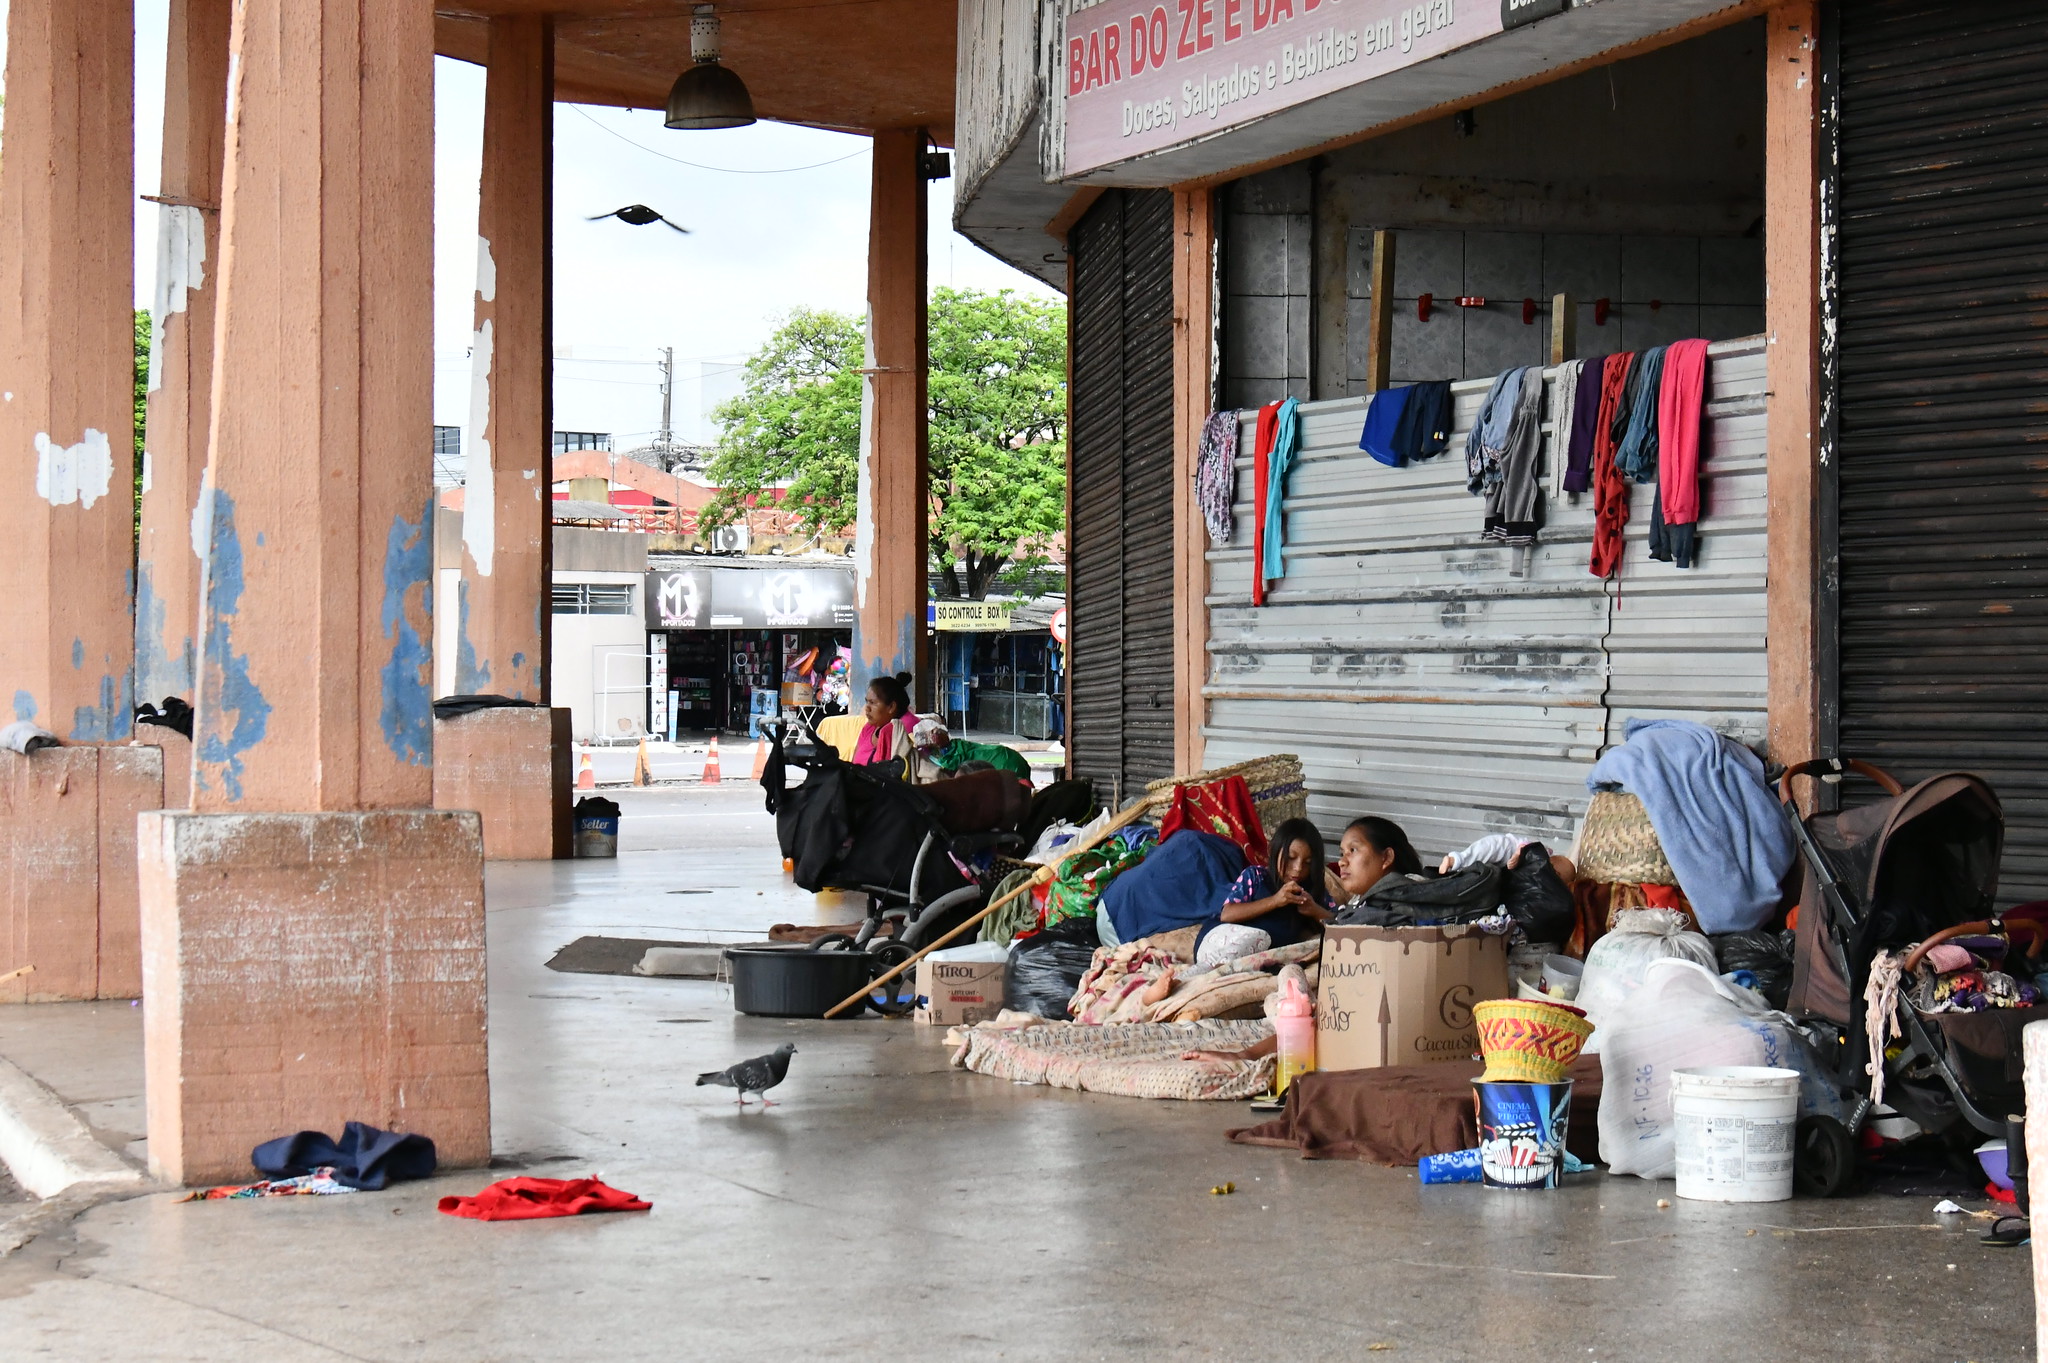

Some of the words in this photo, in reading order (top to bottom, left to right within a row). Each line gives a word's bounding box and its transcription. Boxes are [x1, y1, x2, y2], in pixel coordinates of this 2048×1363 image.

[1069, 22, 1122, 98] BAR
[1130, 5, 1168, 78] DO
[1223, 0, 1242, 45] E
[1123, 96, 1177, 137] Doces,
[1181, 62, 1260, 119] Salgados
[1265, 59, 1277, 90] e
[1282, 27, 1357, 85] Bebidas
[1363, 16, 1395, 55] em
[1400, 0, 1454, 53] geral
[948, 606, 982, 619] CONTROLE
[987, 606, 1000, 619] BOX
[938, 964, 977, 979] TIROL
[1414, 1033, 1482, 1053] CacauSh
[1497, 1102, 1531, 1110] CINEMA
[1497, 1112, 1531, 1121] PIPOCA
